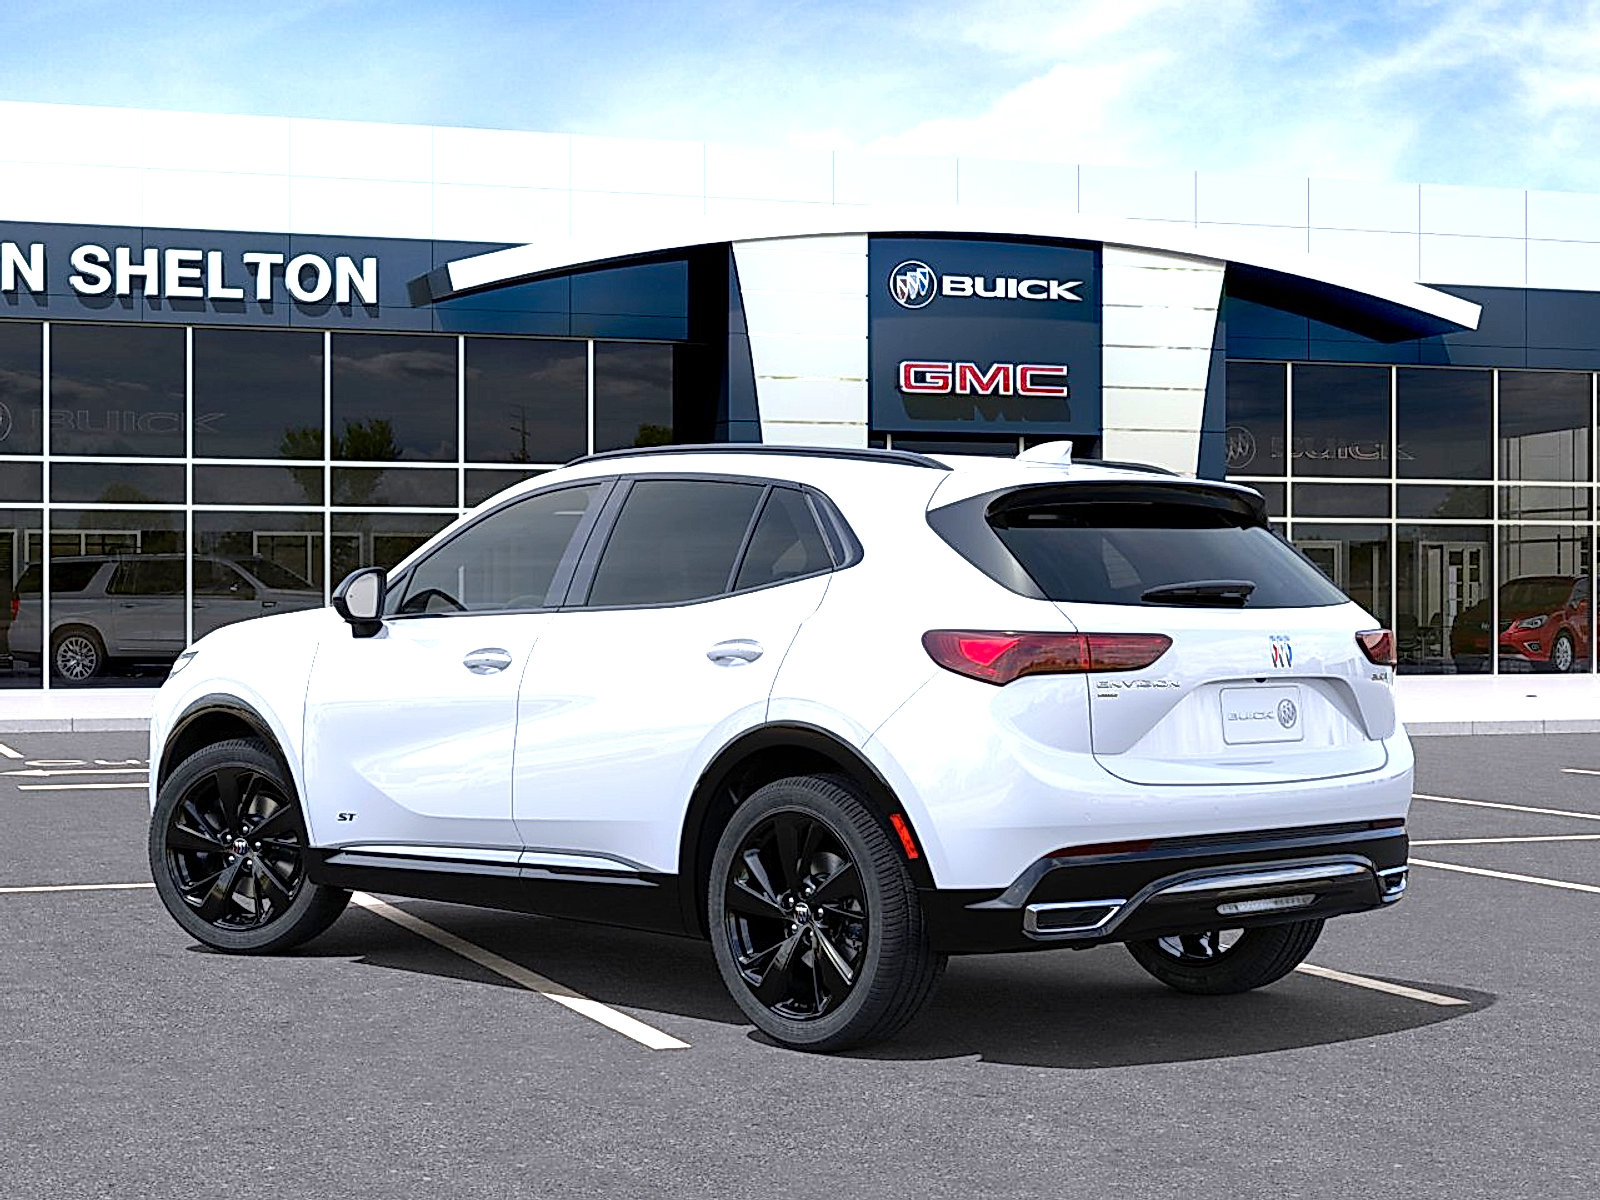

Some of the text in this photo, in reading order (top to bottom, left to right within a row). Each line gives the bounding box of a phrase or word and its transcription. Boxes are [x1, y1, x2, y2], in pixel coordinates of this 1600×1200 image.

[69, 244, 377, 303] SHELTON
[942, 275, 1083, 301] BUICK
[900, 361, 1067, 397] GMC
[32, 410, 224, 432] BUICK
[337, 813, 357, 821] ST
